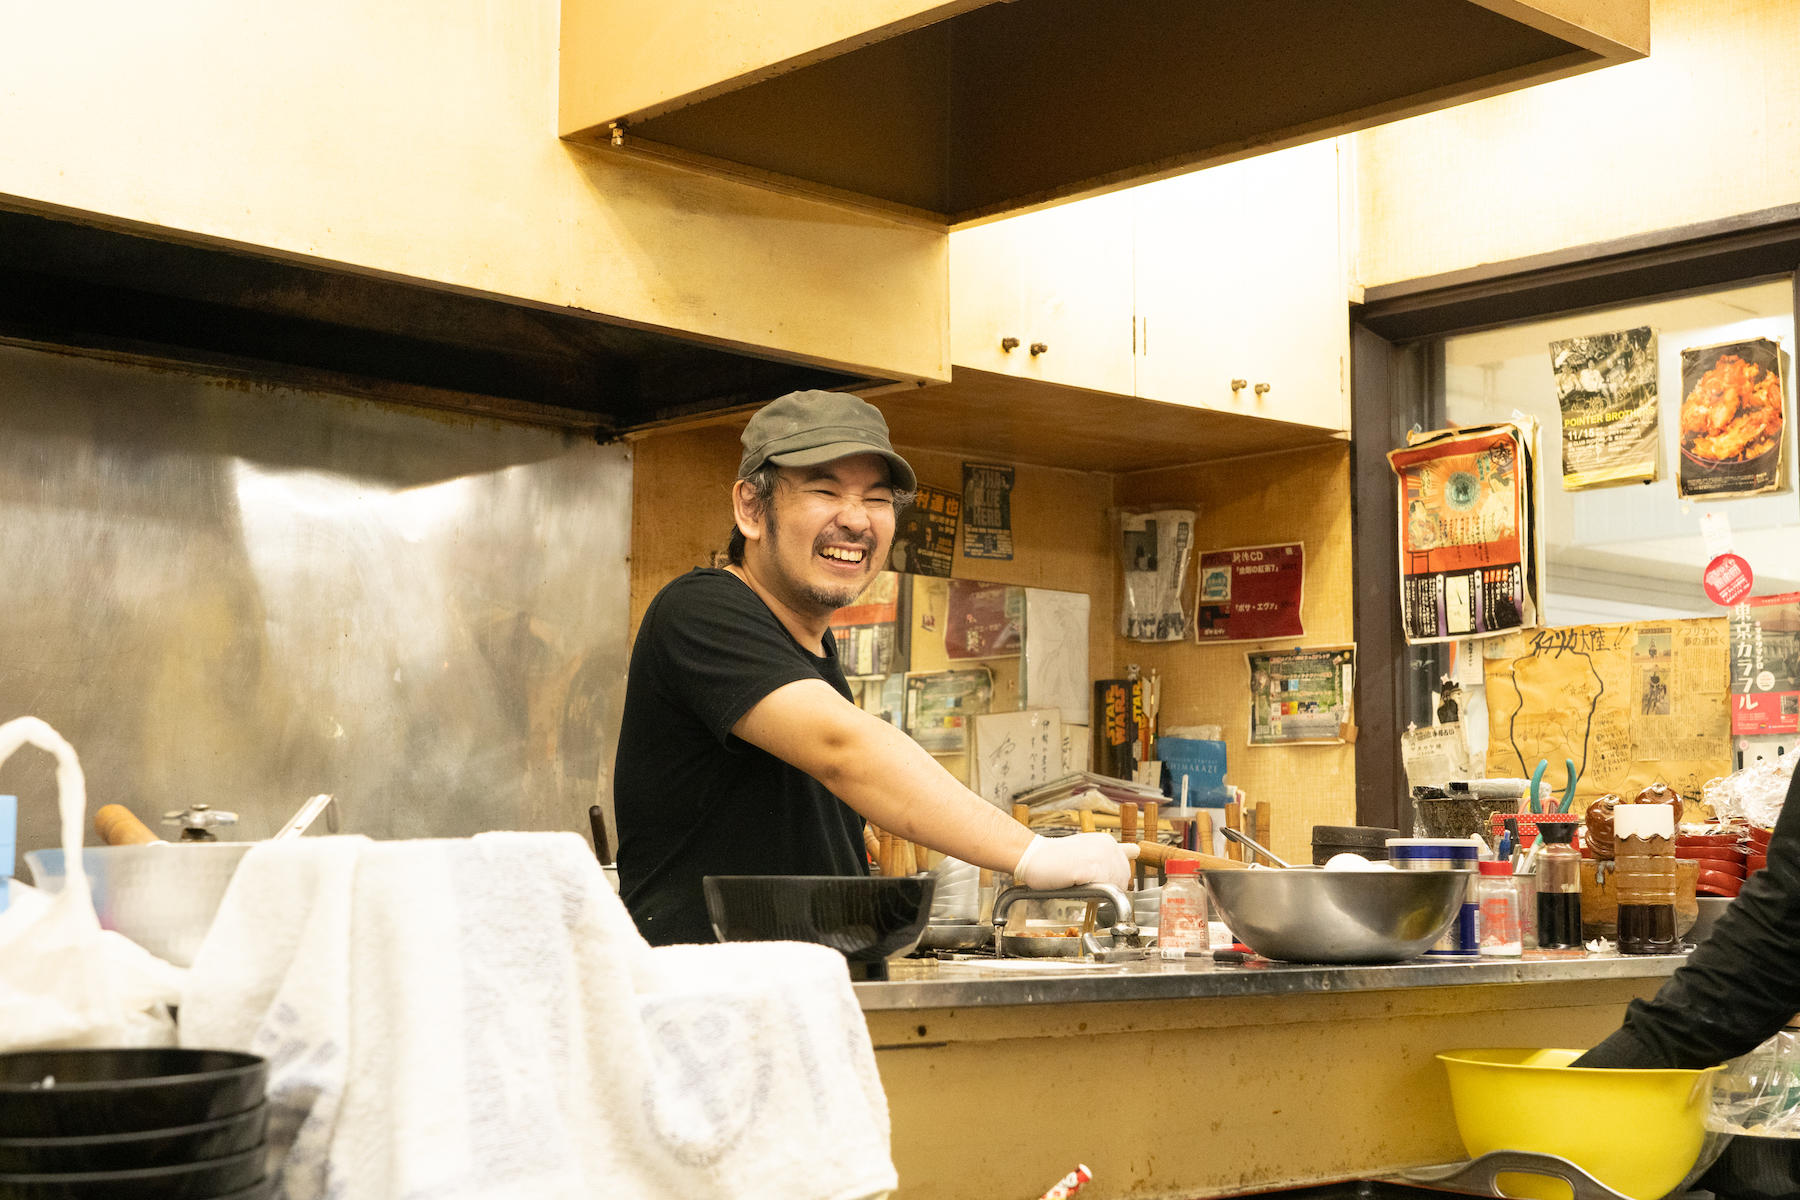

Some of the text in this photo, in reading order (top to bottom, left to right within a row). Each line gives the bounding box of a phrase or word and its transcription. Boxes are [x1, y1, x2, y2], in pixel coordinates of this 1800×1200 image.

[1564, 414, 1604, 428] POINTER
[1567, 428, 1595, 441] 11/15
[973, 488, 1001, 507] BLUE
[973, 506, 1002, 527] HERB
[1674, 626, 1720, 637] アフリカへ
[1683, 636, 1726, 647] 夢の道続く
[1735, 602, 1760, 710] 東京カラフル
[1105, 685, 1126, 746] STAR WARS
